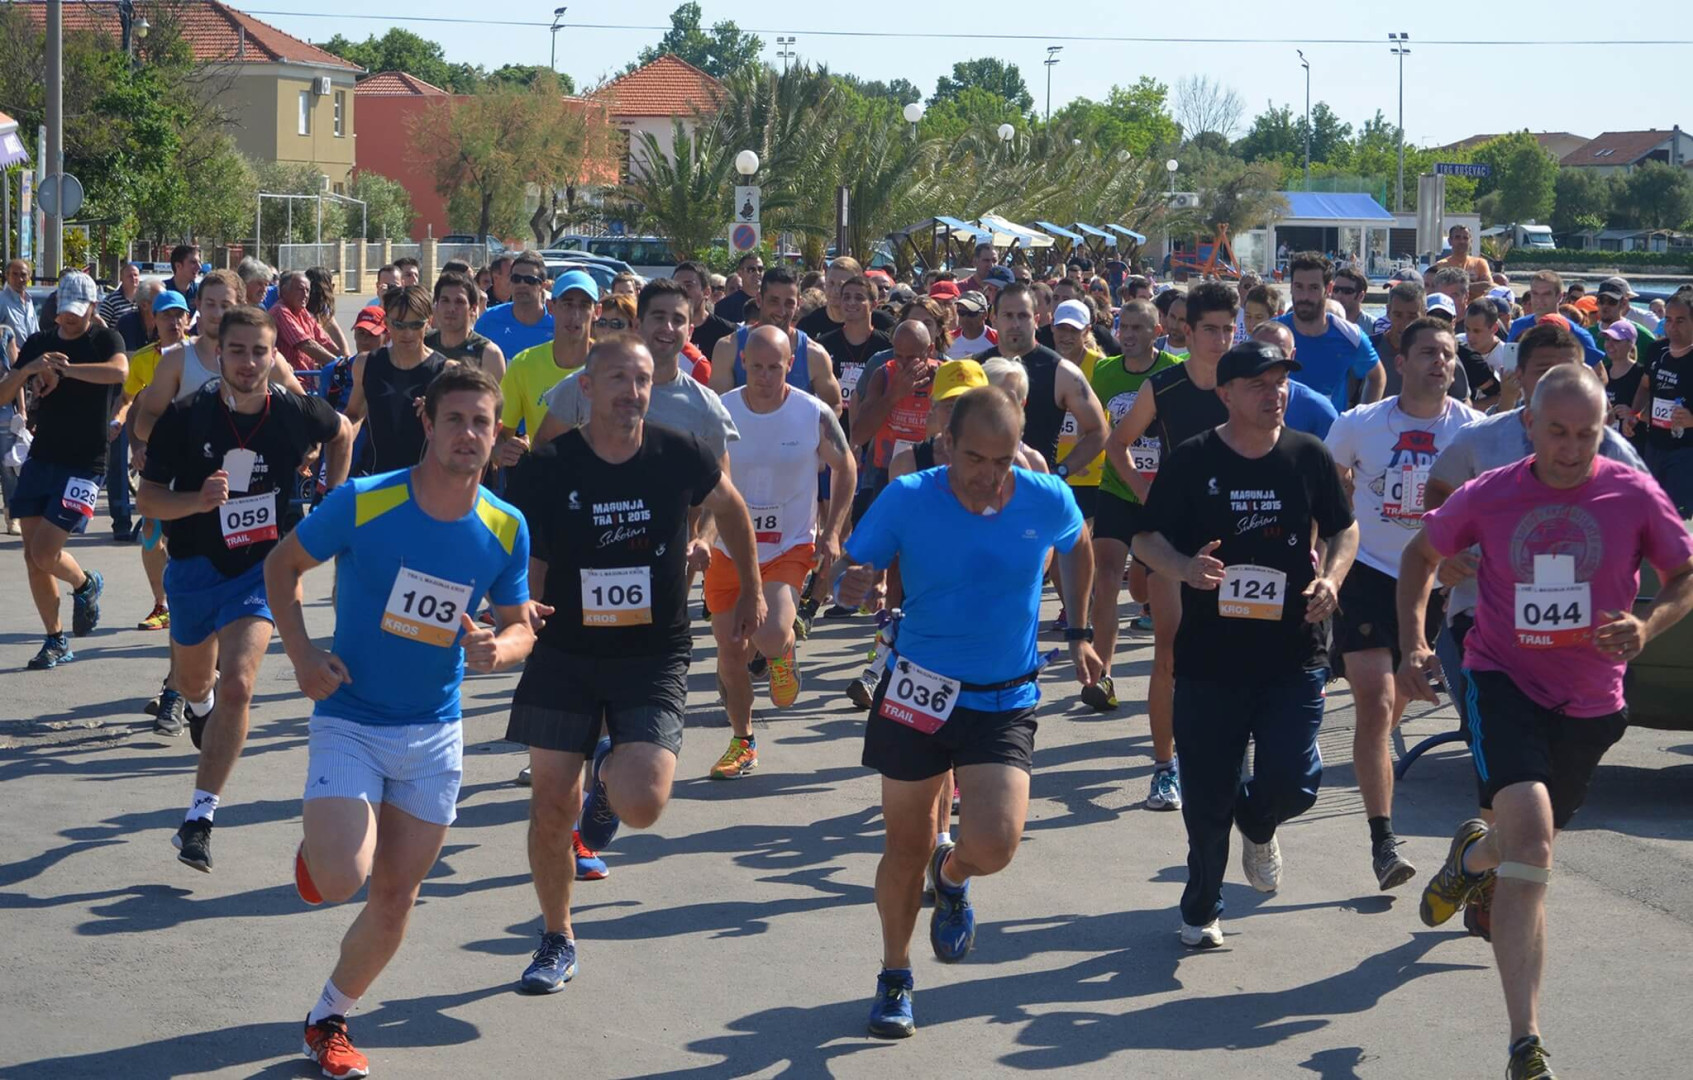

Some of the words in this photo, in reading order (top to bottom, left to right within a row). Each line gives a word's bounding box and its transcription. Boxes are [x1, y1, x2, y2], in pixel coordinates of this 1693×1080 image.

[1655, 406, 1673, 418] 02
[1134, 457, 1154, 470] 53
[70, 486, 96, 506] 029
[1230, 490, 1275, 500] MAGUNJA
[592, 499, 644, 514] MAGUNJA
[1261, 501, 1282, 510] 2015
[227, 507, 269, 530] 059
[627, 510, 651, 522] 2015
[754, 515, 777, 530] 18
[227, 534, 250, 546] TRAIL
[592, 584, 643, 606] 106
[1230, 579, 1277, 600] 124
[403, 590, 457, 624] 103
[1221, 604, 1250, 615] KROS
[1523, 602, 1582, 626] 044
[585, 614, 617, 623] KROS
[384, 618, 419, 636] KROS
[1518, 634, 1554, 646] TRAIL
[897, 677, 948, 713] 036
[884, 703, 914, 724] TRAIL
